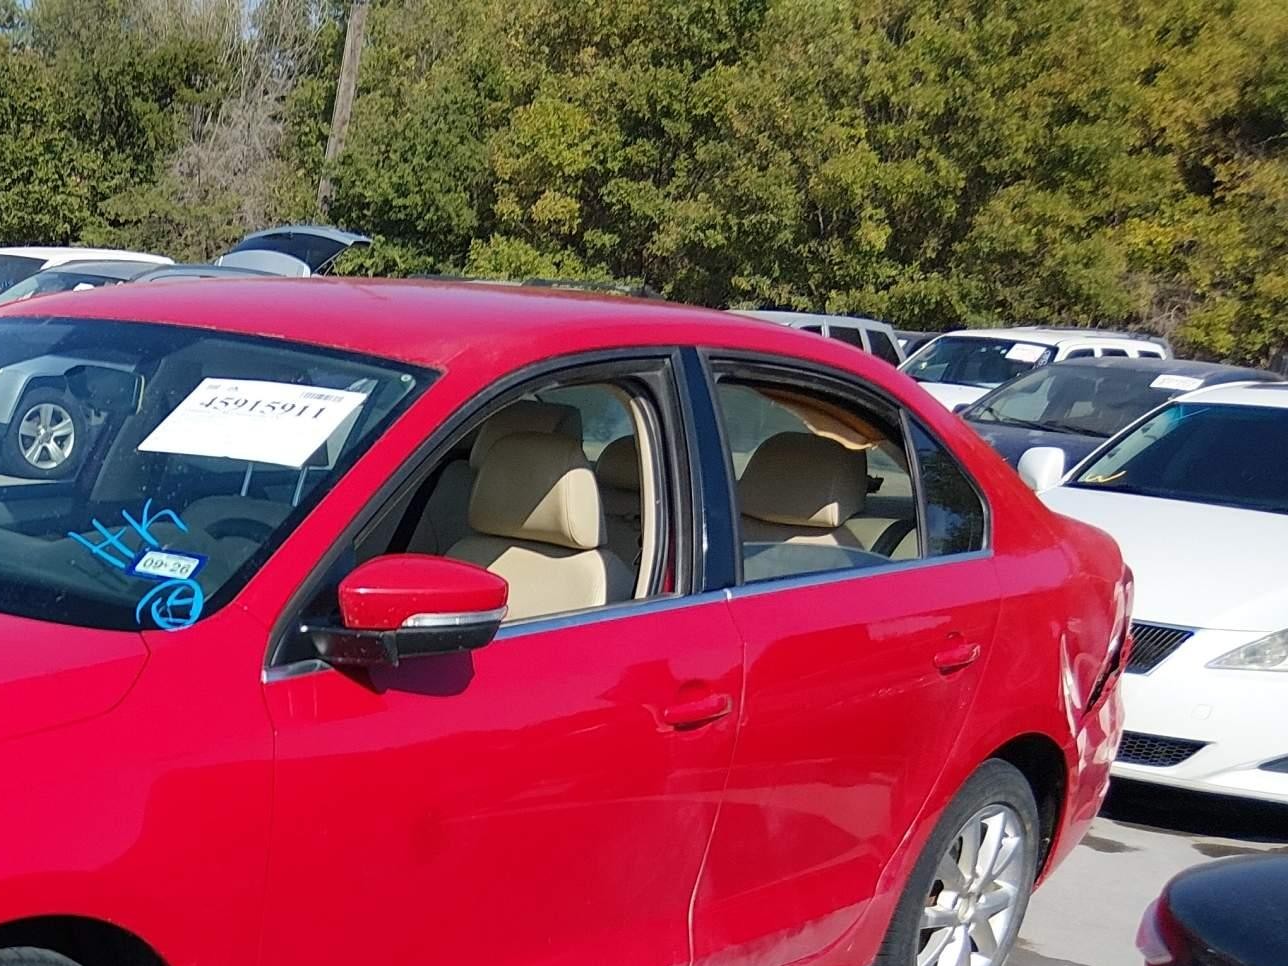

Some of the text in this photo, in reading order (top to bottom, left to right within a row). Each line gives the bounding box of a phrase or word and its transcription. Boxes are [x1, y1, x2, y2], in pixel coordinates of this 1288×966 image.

[199, 395, 326, 420] 45915911
[142, 556, 192, 576] 09 26
